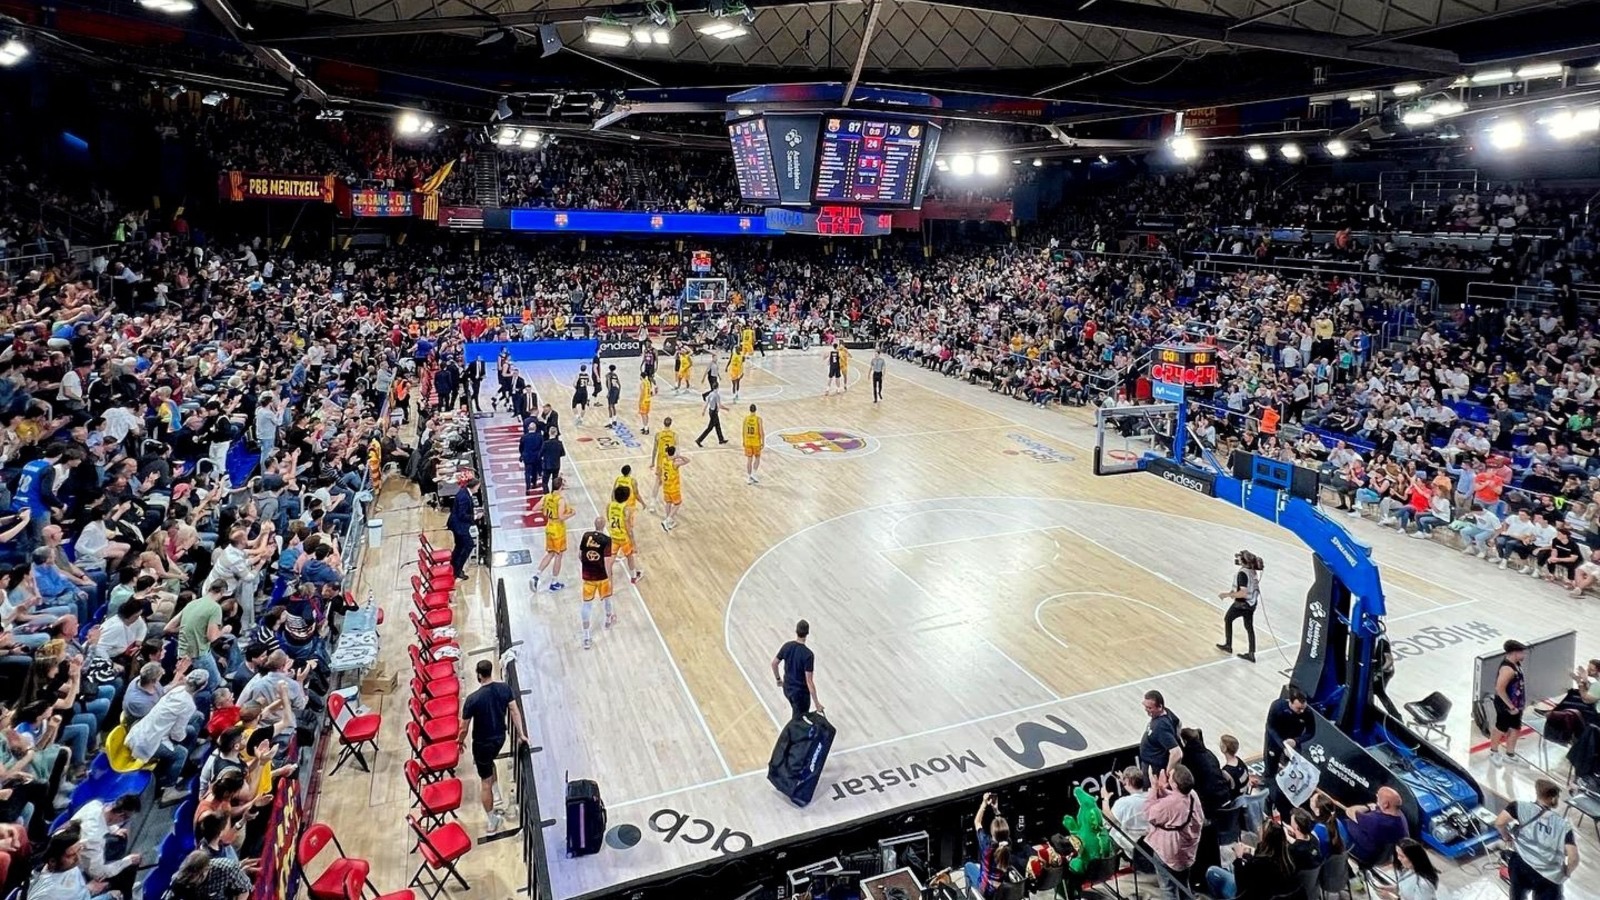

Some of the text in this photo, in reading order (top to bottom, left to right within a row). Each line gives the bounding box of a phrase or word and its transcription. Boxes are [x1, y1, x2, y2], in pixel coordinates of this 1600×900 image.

[848, 122, 861, 133] 87
[889, 126, 901, 136] 79
[867, 140, 878, 148] 24
[270, 180, 320, 196] MERITXELL
[600, 341, 640, 351] endesa
[1163, 470, 1203, 492] endesa
[611, 517, 621, 529] 24
[831, 749, 987, 801] Movistar
[648, 808, 753, 855] acb
